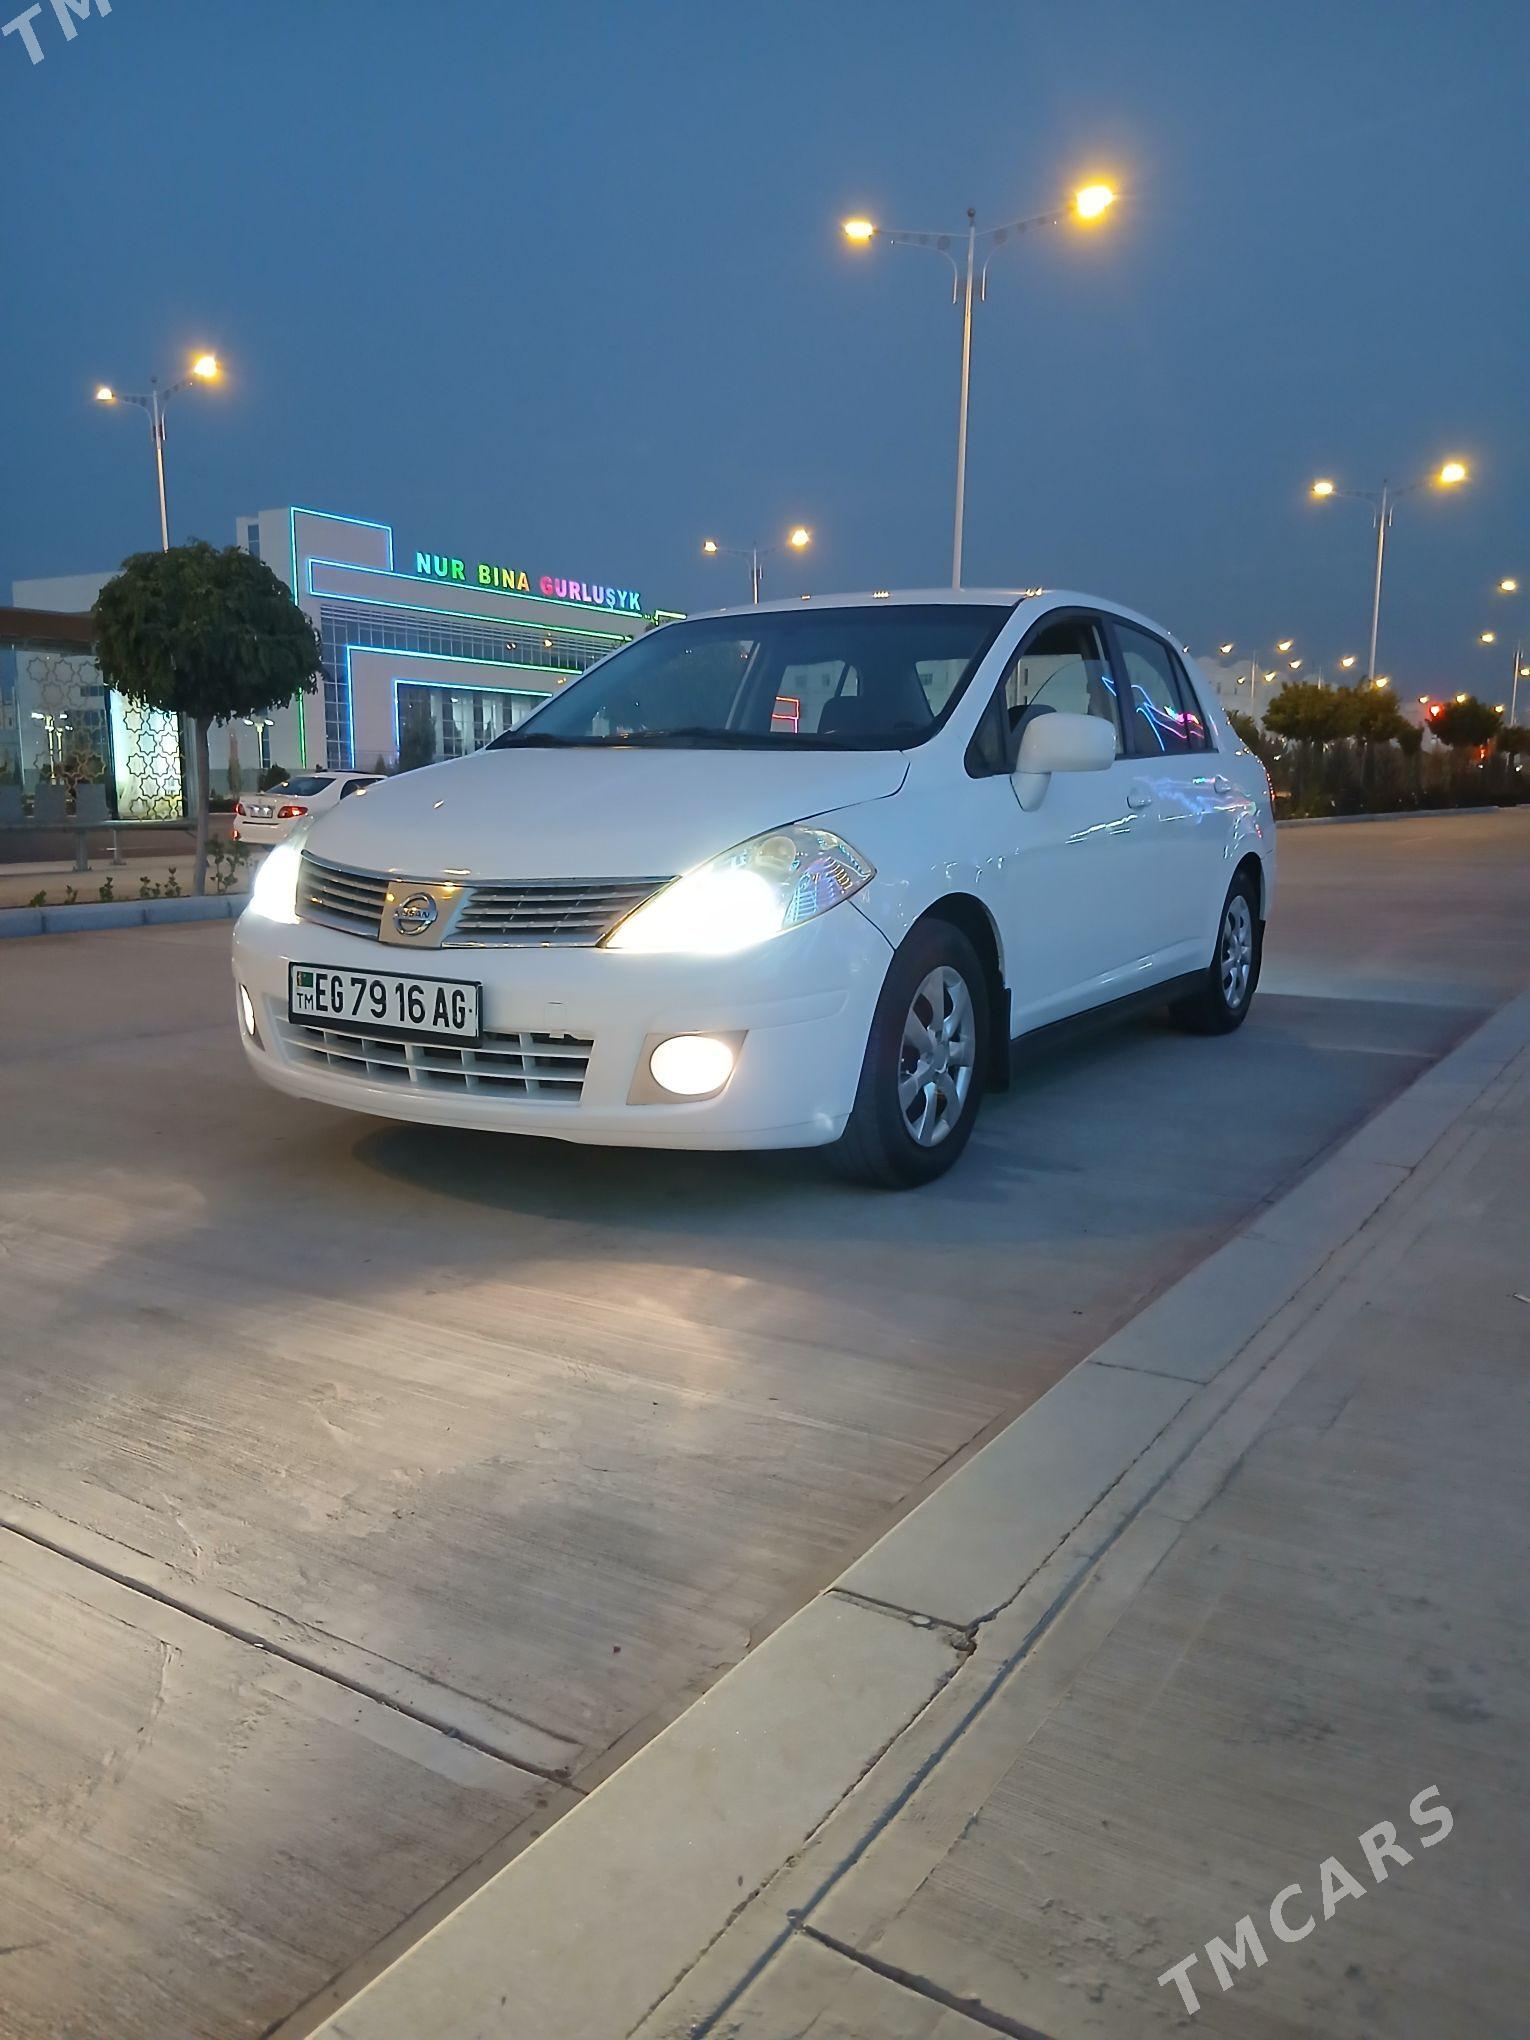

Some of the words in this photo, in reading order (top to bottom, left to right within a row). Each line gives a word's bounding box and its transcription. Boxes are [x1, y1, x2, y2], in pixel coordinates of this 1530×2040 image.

[415, 552, 465, 581] NUR
[477, 564, 530, 592] BINA
[540, 576, 641, 611] GURLUŞYK
[297, 992, 314, 1011] TM
[316, 973, 344, 1013] EG
[433, 987, 466, 1029] AG
